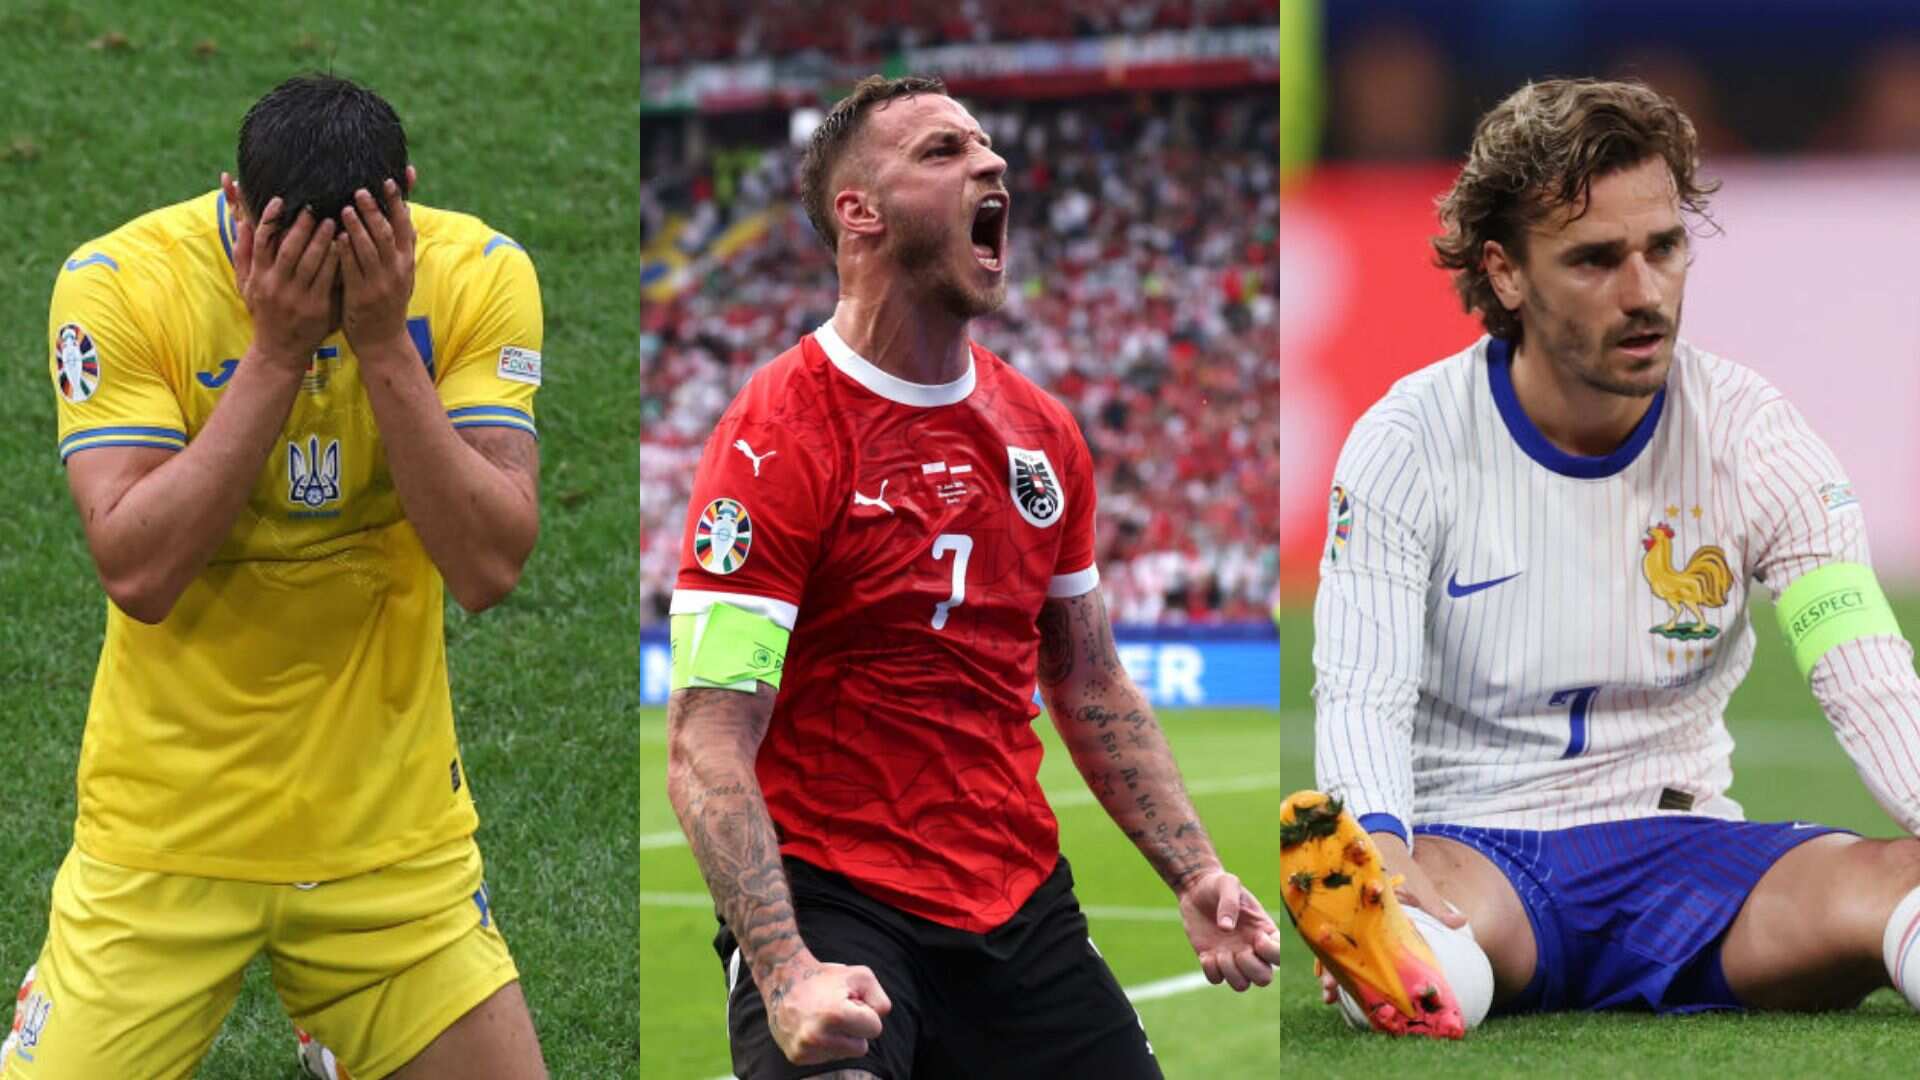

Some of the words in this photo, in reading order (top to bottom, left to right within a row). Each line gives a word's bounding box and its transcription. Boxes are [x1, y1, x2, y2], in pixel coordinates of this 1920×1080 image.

[931, 534, 974, 630] 7
[1792, 591, 1864, 639] RESPECT
[1548, 685, 1601, 760] 7
